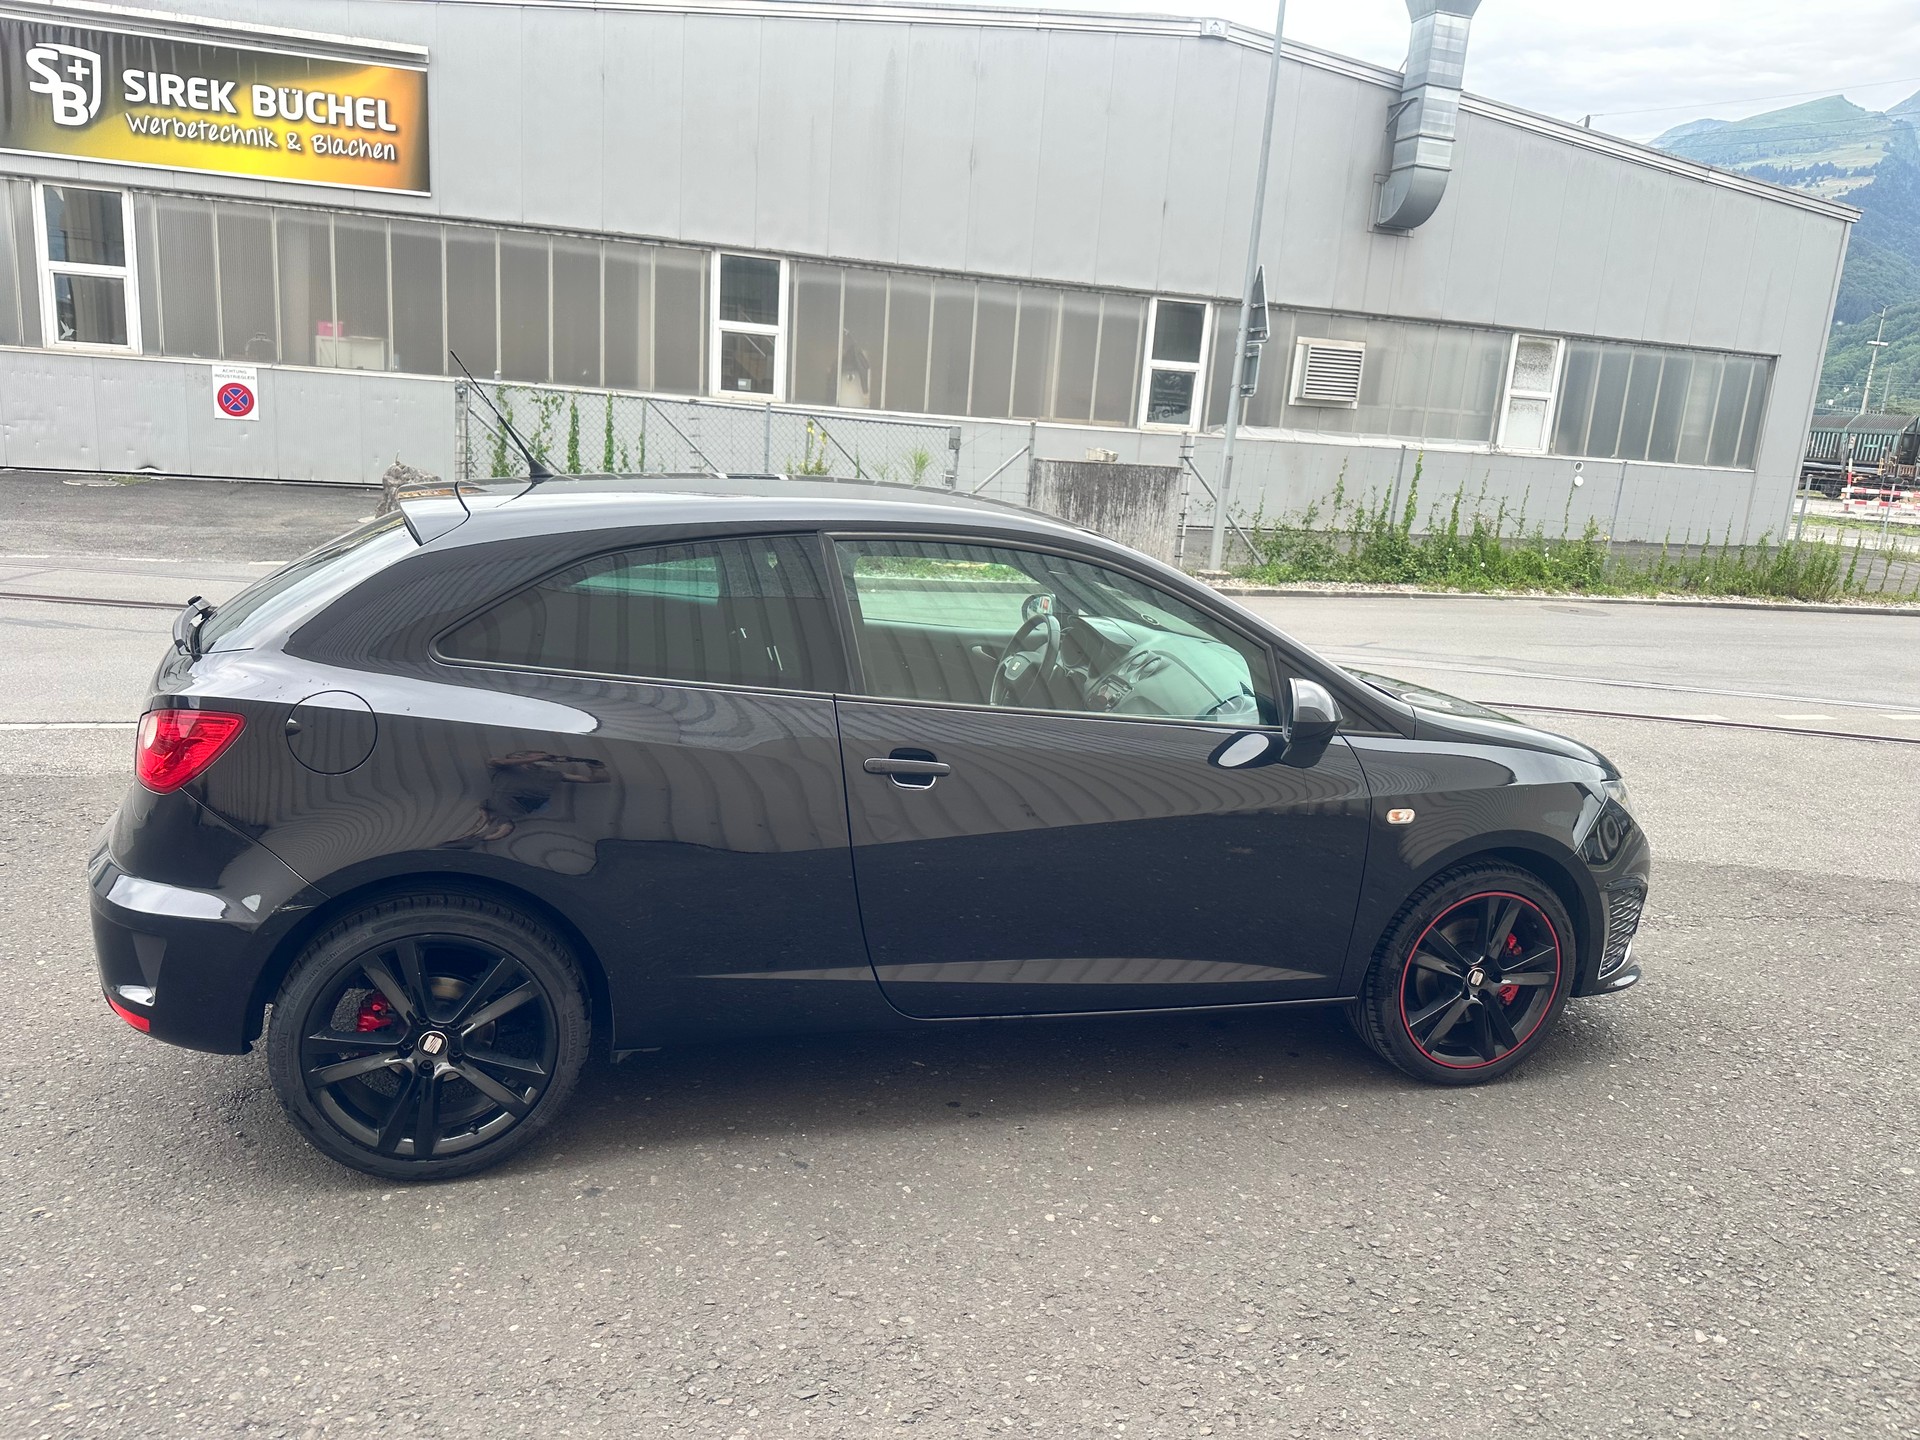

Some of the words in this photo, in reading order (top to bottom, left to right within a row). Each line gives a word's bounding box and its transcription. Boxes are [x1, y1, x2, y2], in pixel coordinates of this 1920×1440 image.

[122, 68, 238, 114] SIREK
[251, 84, 397, 132] BÜCHEL
[124, 112, 279, 149] Werbetechnik
[286, 131, 302, 151] &
[310, 133, 396, 161] Blachen
[276, 1030, 289, 1081] NIROYAL
